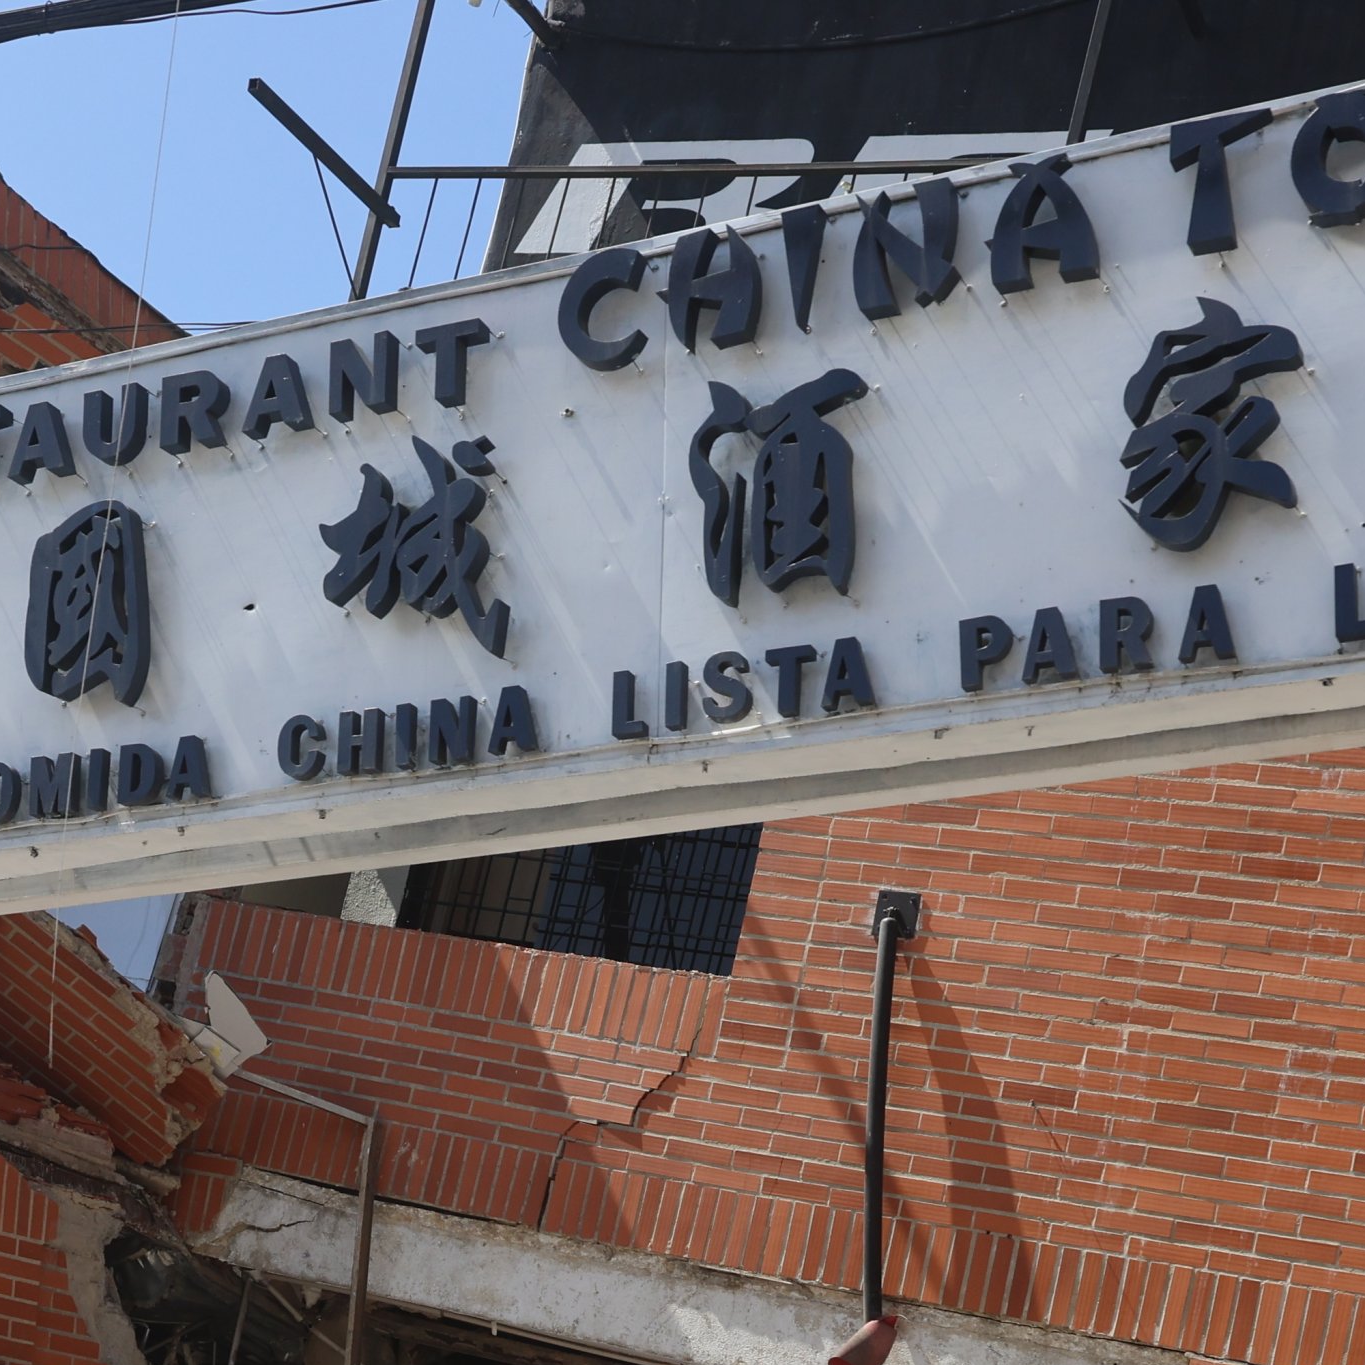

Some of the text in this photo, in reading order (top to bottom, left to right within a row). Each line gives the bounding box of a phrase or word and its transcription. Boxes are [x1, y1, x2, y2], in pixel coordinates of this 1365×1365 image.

[558, 155, 1101, 372] CHINA
[277, 685, 539, 781] CHINA
[611, 636, 876, 741] LISTA
[958, 583, 1235, 692] PARA
